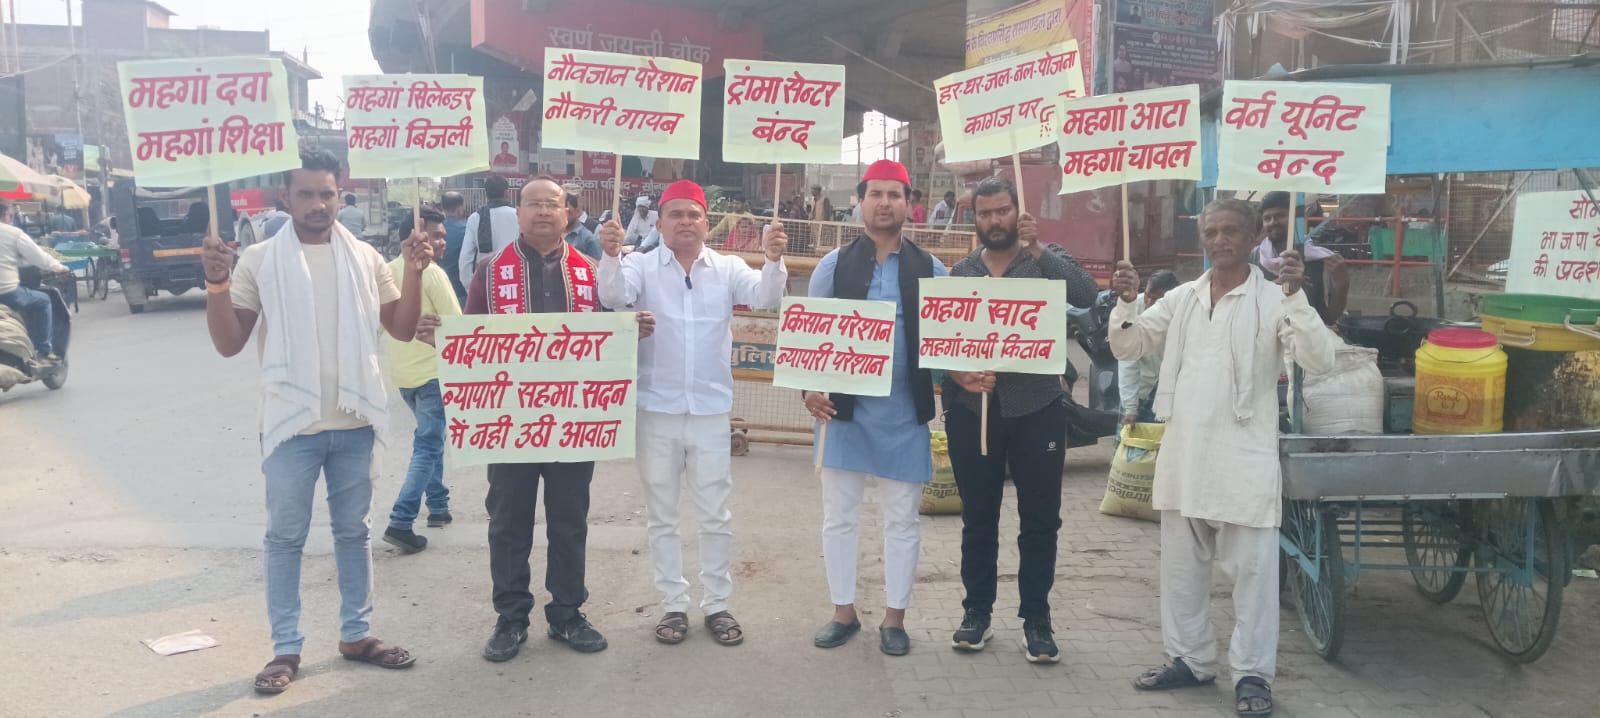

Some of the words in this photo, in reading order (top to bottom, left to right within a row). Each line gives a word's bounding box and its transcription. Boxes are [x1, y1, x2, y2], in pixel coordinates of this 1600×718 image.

[547, 24, 593, 49] स्वर्ण
[216, 71, 272, 106] दवा
[635, 60, 698, 94] परेशान
[783, 71, 841, 107] सेन्टर
[408, 80, 476, 111] सिलेन्डर
[545, 92, 617, 126] नौकरी
[964, 104, 1015, 135] कागज
[1018, 97, 1044, 119] पर
[1130, 99, 1191, 130] आटा
[1280, 95, 1366, 140] यूनिट
[218, 115, 285, 156] शिक्षा
[405, 116, 474, 149] बिजली
[1128, 140, 1197, 169] चावल
[601, 177, 631, 190] परिद
[1533, 253, 1549, 278] की
[781, 303, 837, 335] किसान
[838, 310, 894, 343] परेशान
[988, 298, 1047, 331] खाद
[546, 324, 613, 361] लेकर
[962, 332, 998, 359] कापी
[1001, 333, 1056, 359] किताब
[832, 346, 889, 377] परेशान
[582, 379, 632, 411] सदन
[515, 413, 556, 449] उठी
[559, 419, 621, 448] आवाज
